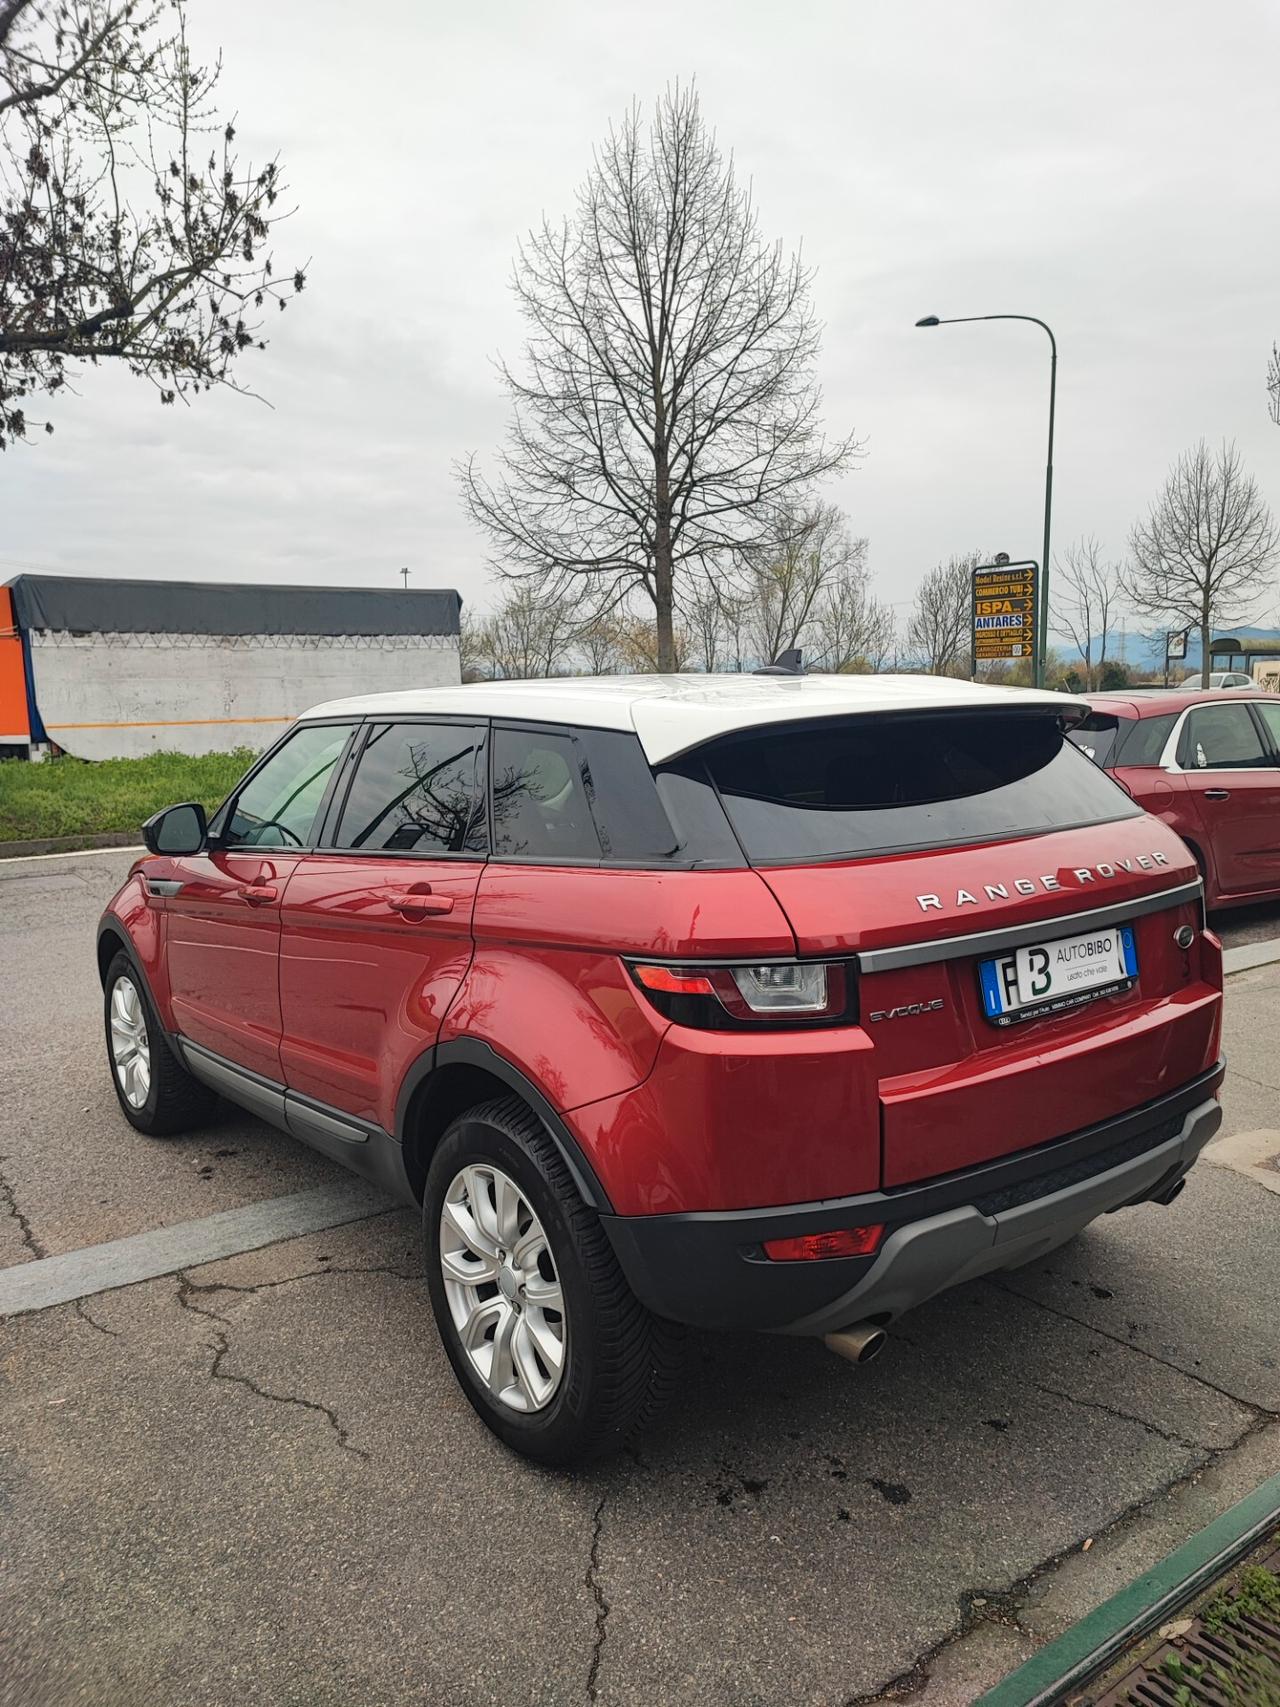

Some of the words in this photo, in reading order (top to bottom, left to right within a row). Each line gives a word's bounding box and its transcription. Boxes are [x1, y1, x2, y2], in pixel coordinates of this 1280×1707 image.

[976, 600, 1012, 615] ISPA
[975, 615, 1022, 629] ANTARES
[916, 874, 1060, 912] RANGE
[1073, 851, 1170, 884] ROVER
[1056, 938, 1112, 964] AUTOBIBO
[1083, 966, 1095, 979] che
[869, 998, 944, 1022] EVOQUE
